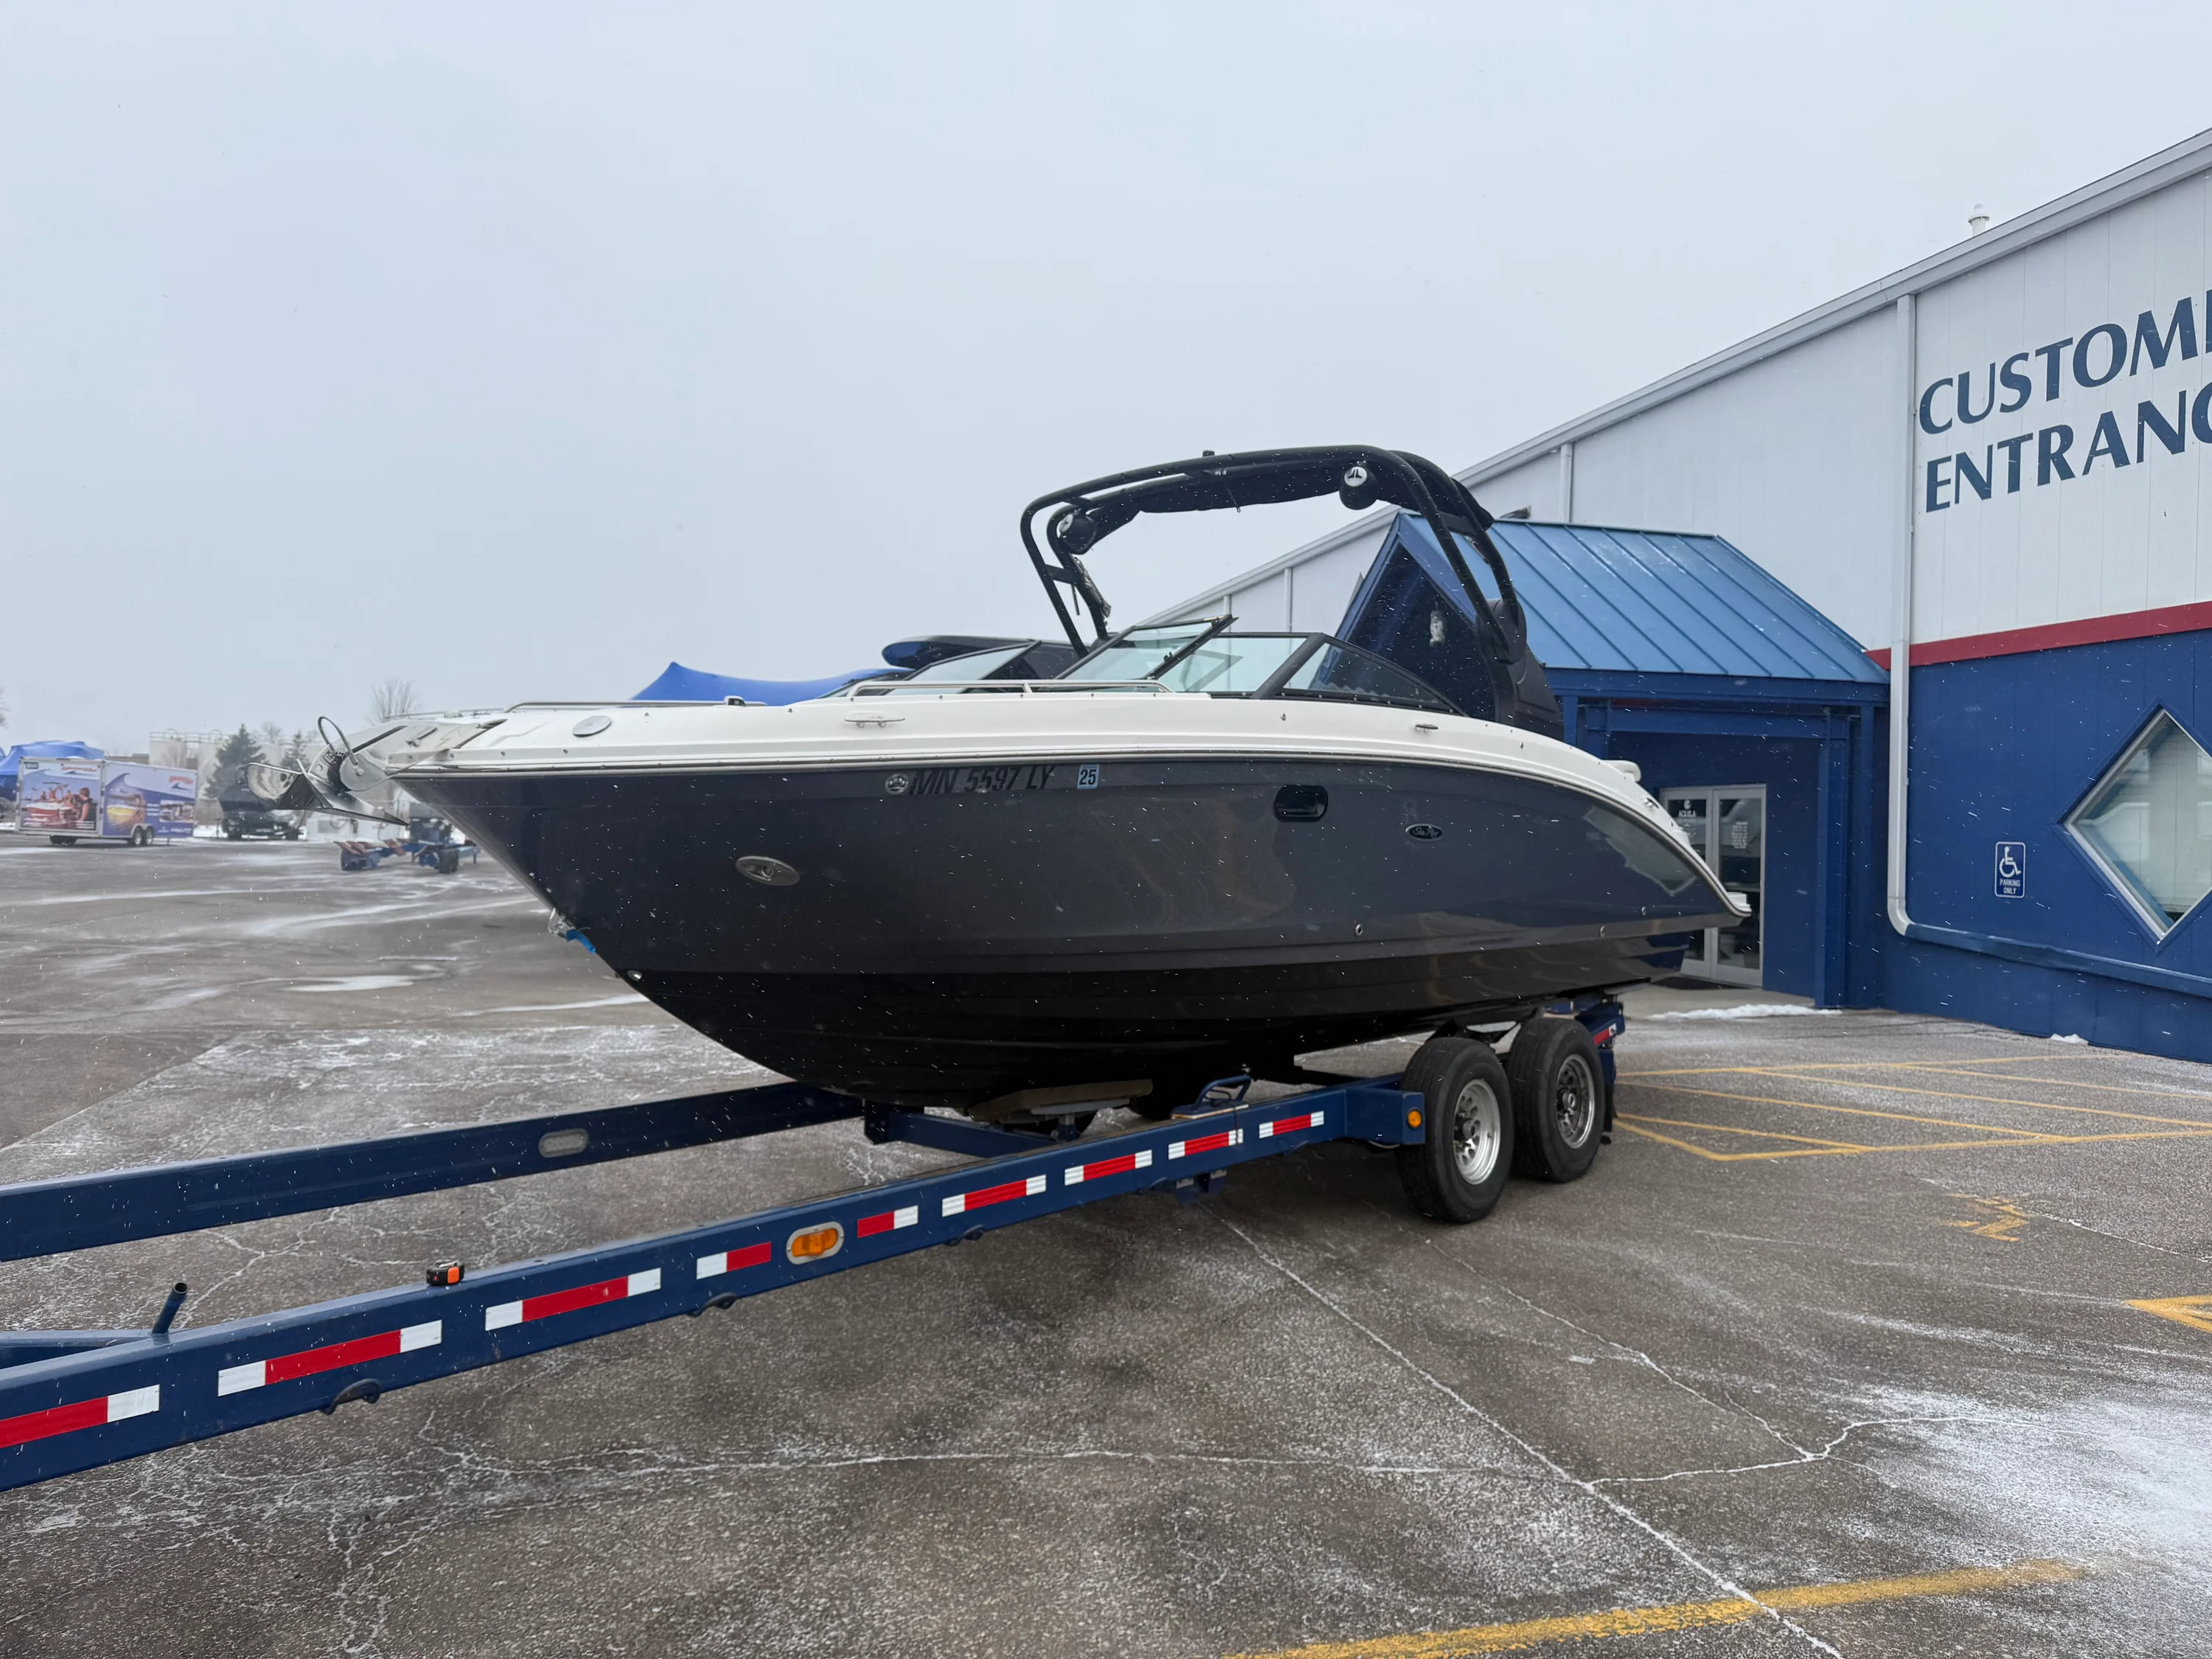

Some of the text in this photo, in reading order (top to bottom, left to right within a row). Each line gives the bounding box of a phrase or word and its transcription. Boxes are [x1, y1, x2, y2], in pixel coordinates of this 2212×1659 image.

[1919, 288, 2212, 434] CUSTOM
[908, 765, 1056, 795] MN 5597 LY
[1079, 769, 1096, 785] 25
[2000, 878, 2020, 887] PARKING
